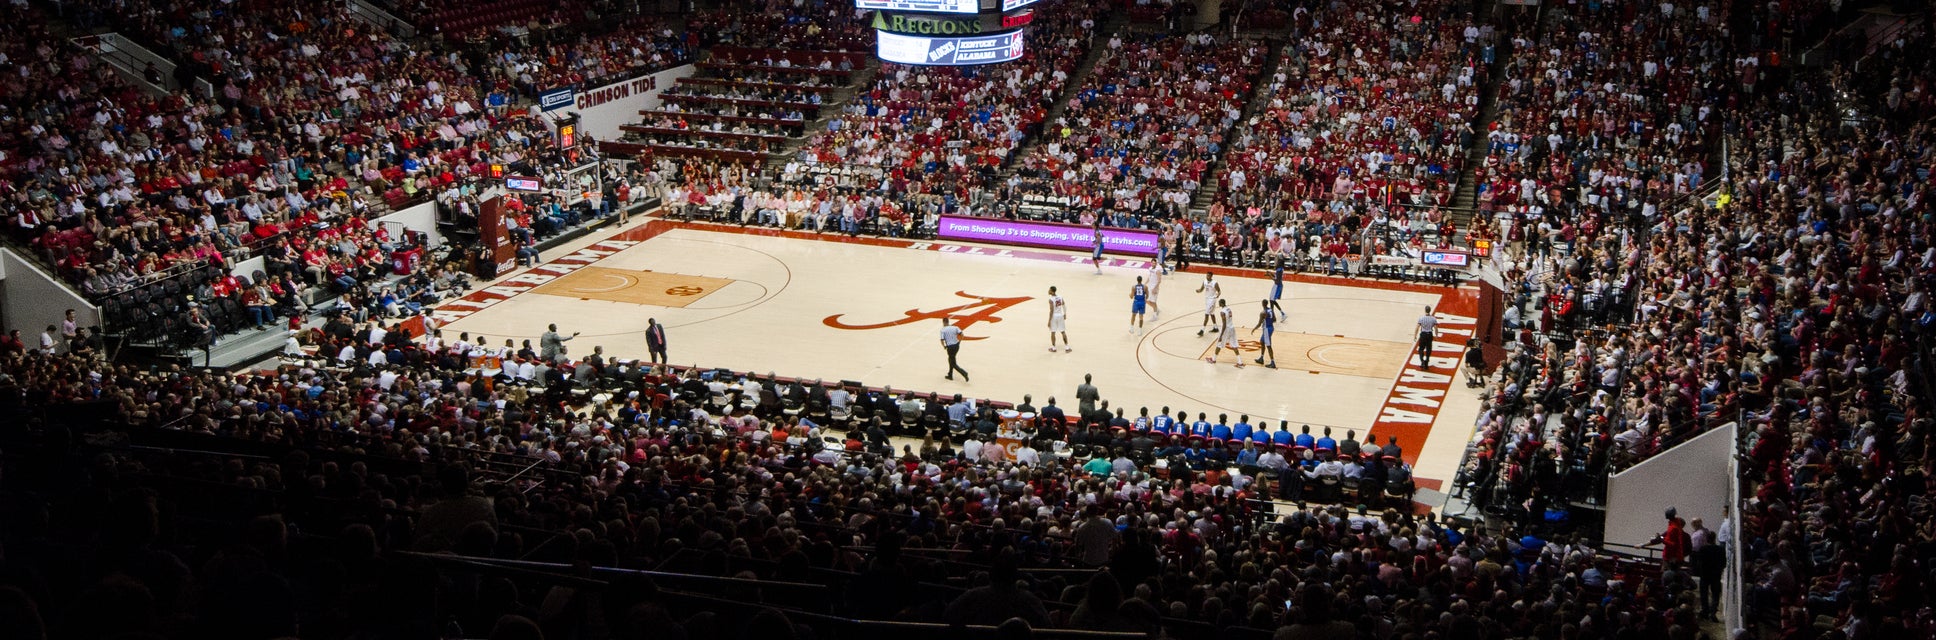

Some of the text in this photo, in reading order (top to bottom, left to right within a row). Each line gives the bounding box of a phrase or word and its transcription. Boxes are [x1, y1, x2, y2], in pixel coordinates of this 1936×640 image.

[892, 15, 982, 34] REGIONS
[929, 41, 956, 62] BLOCKS
[960, 40, 997, 49] KENTUCKY
[957, 51, 996, 61] ALABAMA
[578, 76, 656, 110] CRIMSON TIDE
[949, 223, 970, 232] From
[971, 225, 1006, 236] Shooting
[1007, 227, 1019, 236] 3's
[1030, 230, 1069, 241] Shopping.
[1071, 233, 1089, 242] Visit
[1111, 237, 1153, 248] stvhs.com.
[907, 241, 1015, 258] ROLL
[431, 239, 642, 323] ALABAMA
[1379, 312, 1478, 423] ALABAMA
